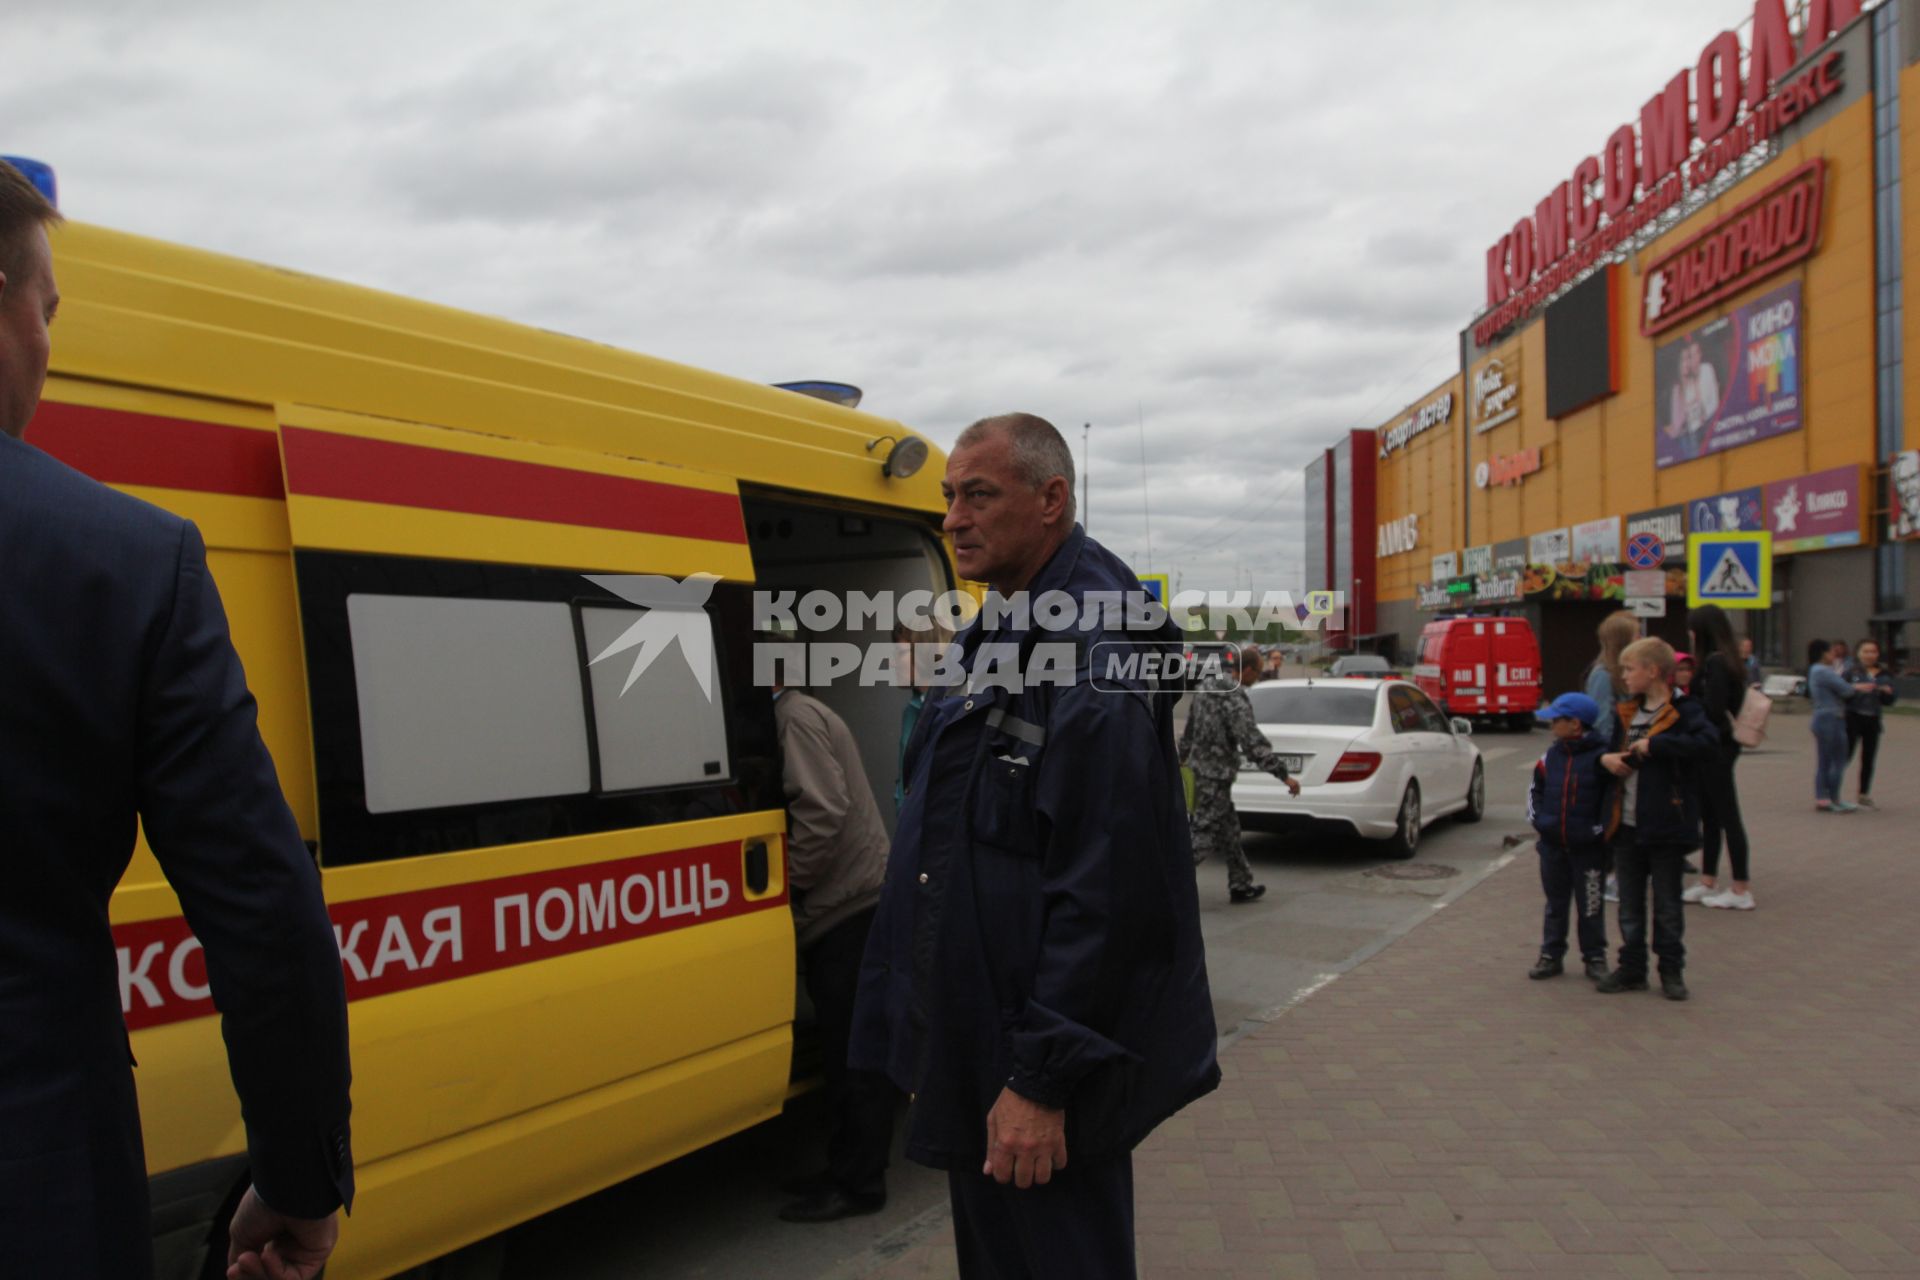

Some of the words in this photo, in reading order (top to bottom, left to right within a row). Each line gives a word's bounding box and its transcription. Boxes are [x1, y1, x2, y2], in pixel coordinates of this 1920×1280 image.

[1662, 181, 1808, 312] ЭЛЬДОРАДО
[1748, 299, 1794, 341] КИНО
[494, 863, 730, 952] ПОМОЩЬ
